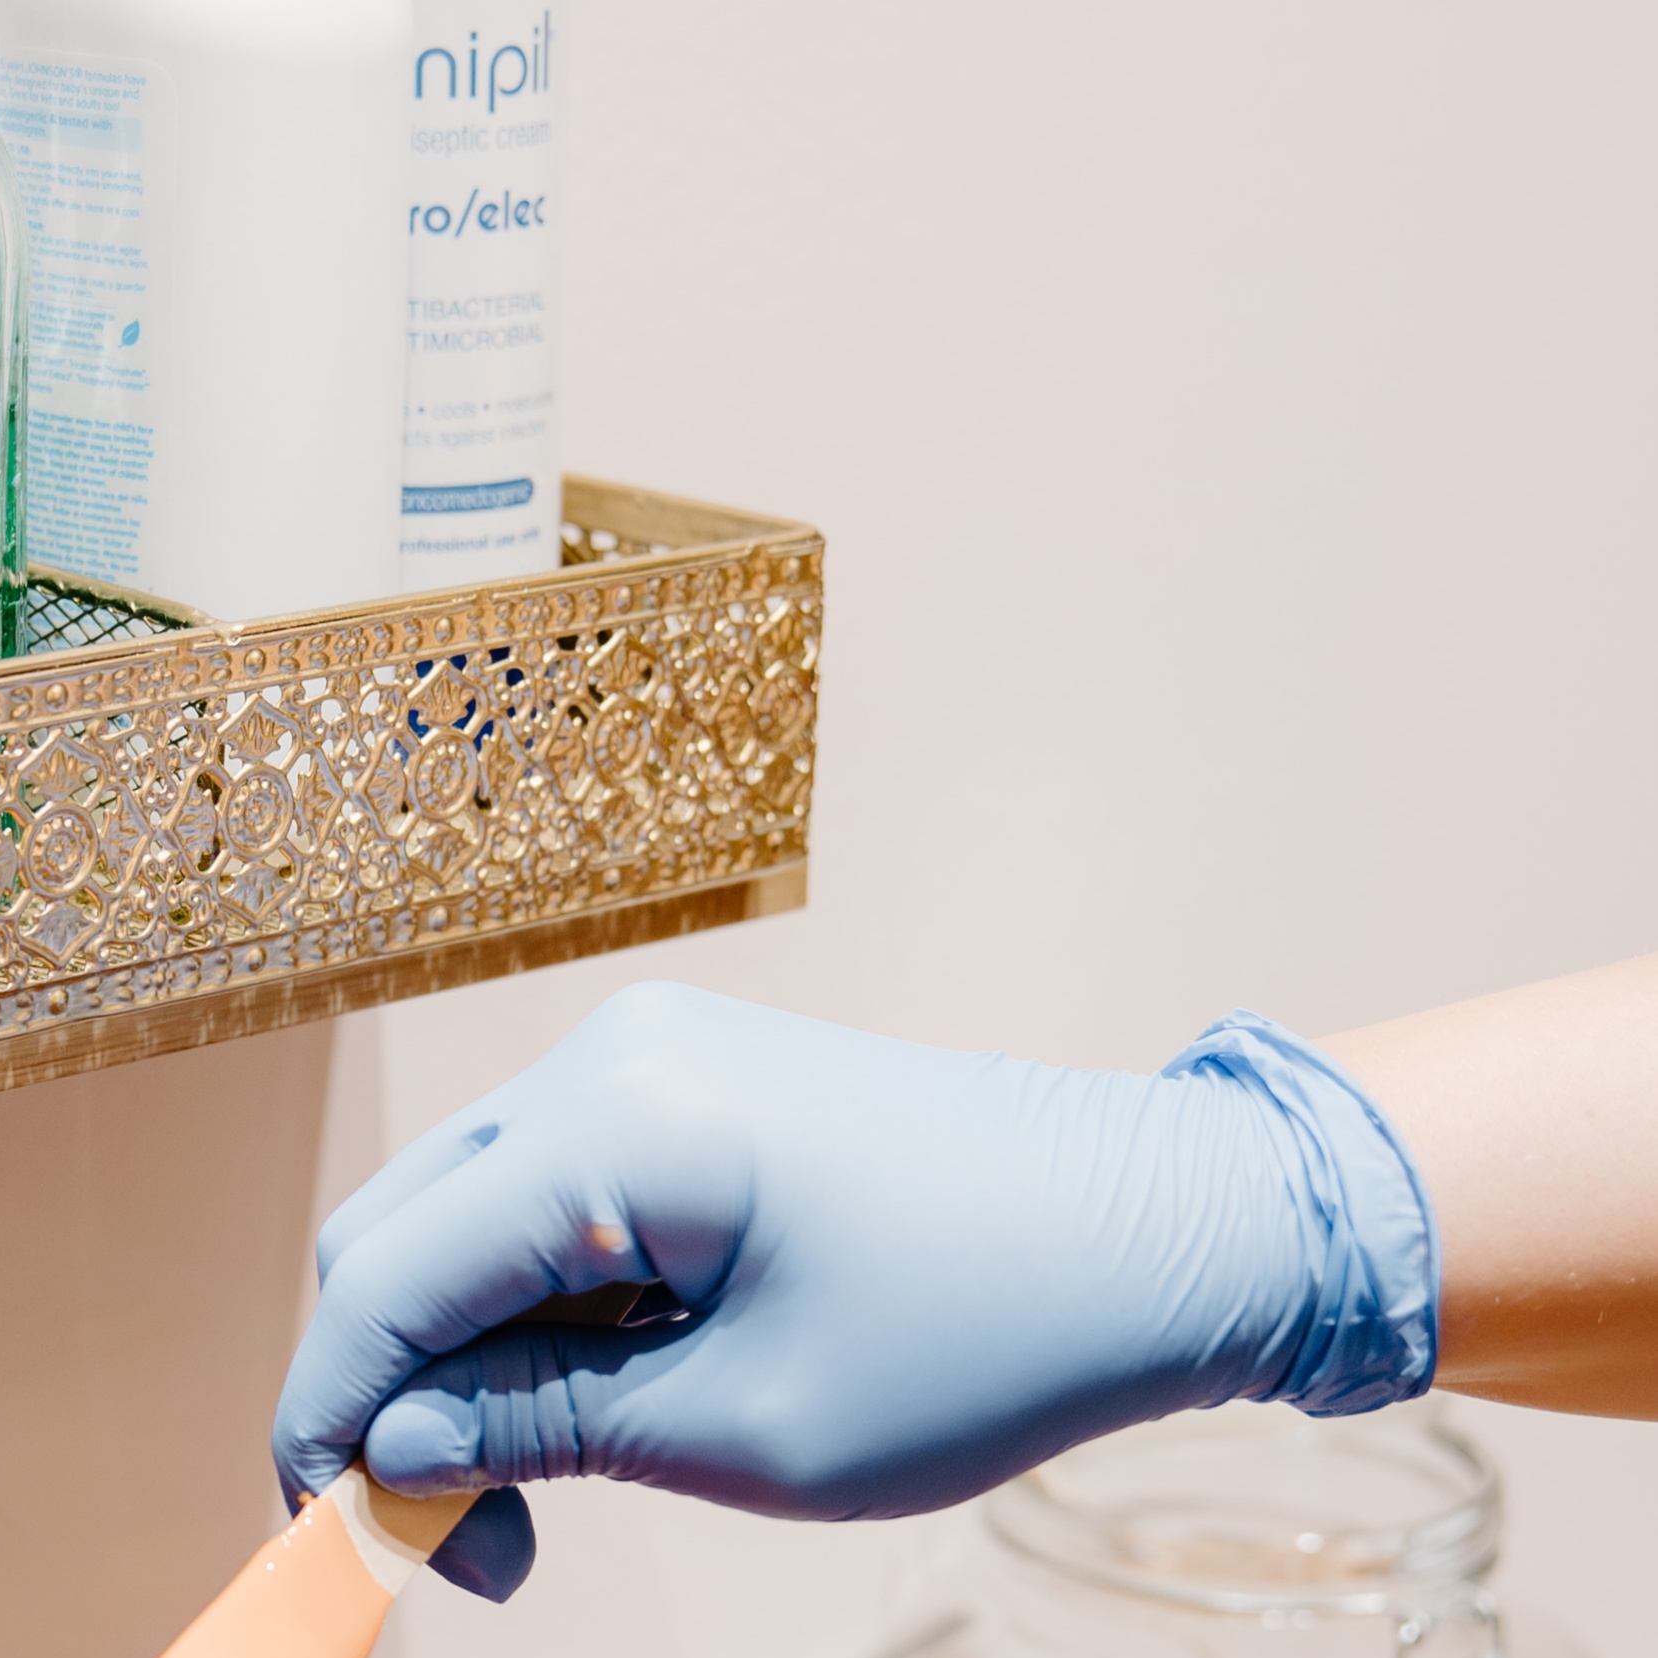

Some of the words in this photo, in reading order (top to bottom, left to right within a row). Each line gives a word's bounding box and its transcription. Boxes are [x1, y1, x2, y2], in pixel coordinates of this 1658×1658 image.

[124, 72, 148, 87] have
[122, 88, 140, 100] and
[58, 115, 90, 130] tested
[91, 119, 113, 132] with
